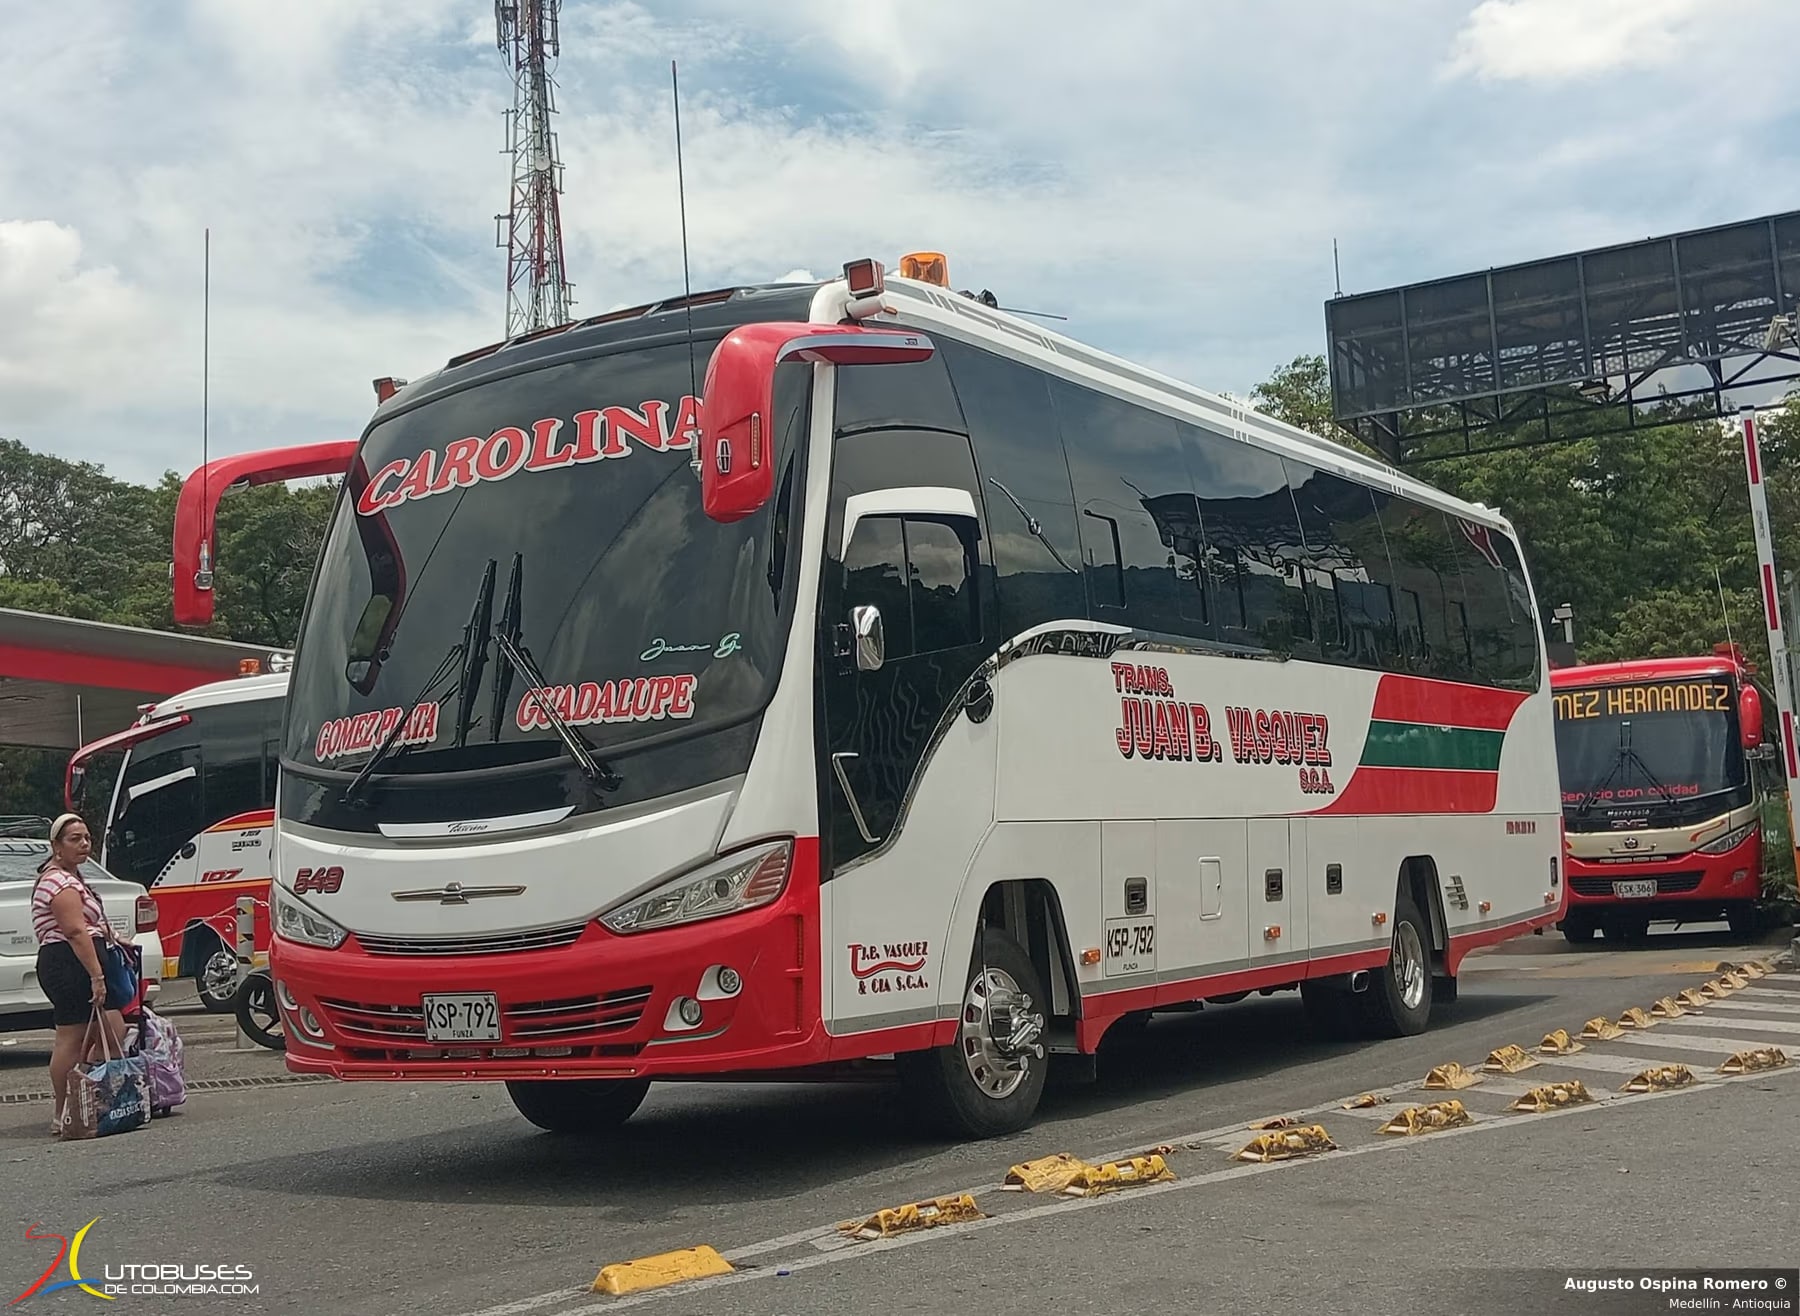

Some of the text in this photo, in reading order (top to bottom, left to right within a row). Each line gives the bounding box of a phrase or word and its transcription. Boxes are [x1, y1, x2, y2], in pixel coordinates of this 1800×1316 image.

[357, 395, 703, 516] CAROLINA
[516, 674, 698, 733] GUADALUPE
[1111, 662, 1174, 697] TRANS.
[1606, 684, 1731, 716] HERNANDEZ
[315, 710, 384, 762] GOMEZ
[1116, 697, 1332, 767] JUAN B. VASQUEZ
[883, 941, 928, 958] VASQUEZ
